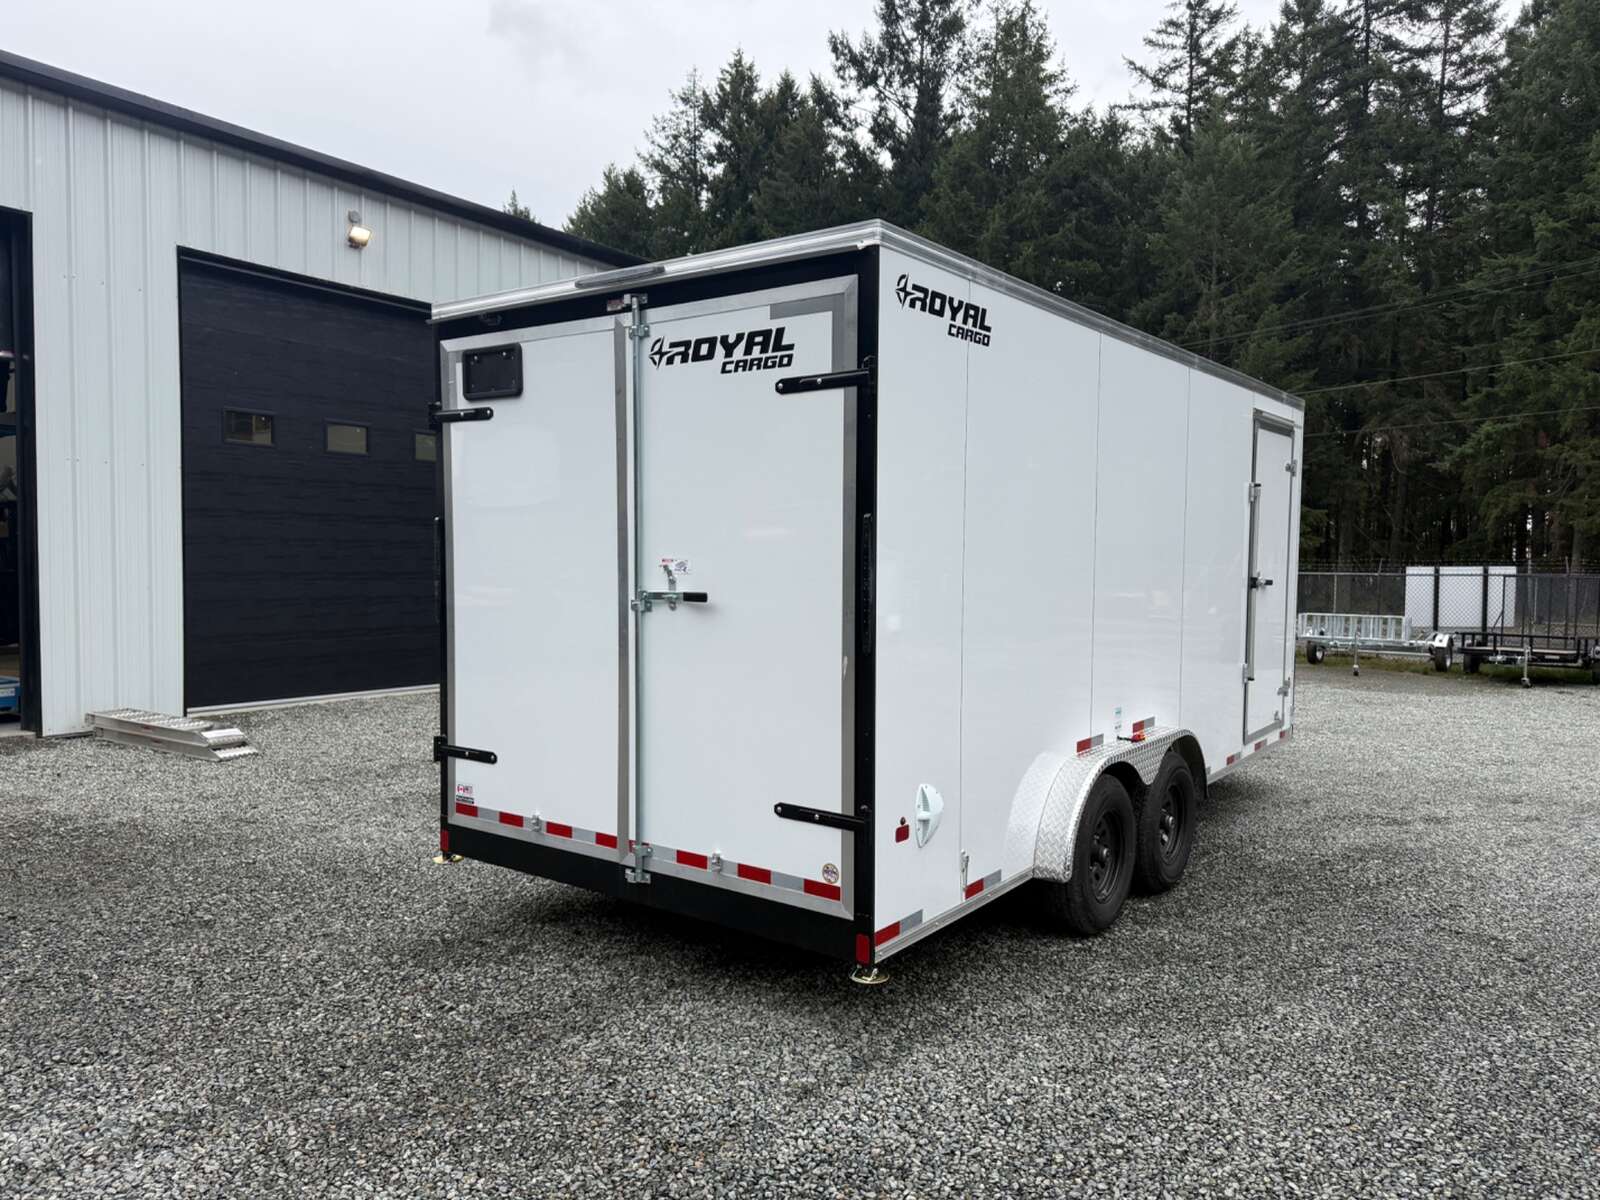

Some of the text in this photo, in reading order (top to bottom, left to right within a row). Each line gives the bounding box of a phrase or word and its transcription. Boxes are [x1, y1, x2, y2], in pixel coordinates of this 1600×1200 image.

[908, 283, 992, 333] ROYAL
[665, 326, 795, 366] ROYAL
[947, 323, 991, 347] CARGO
[720, 353, 794, 374] CARGO
